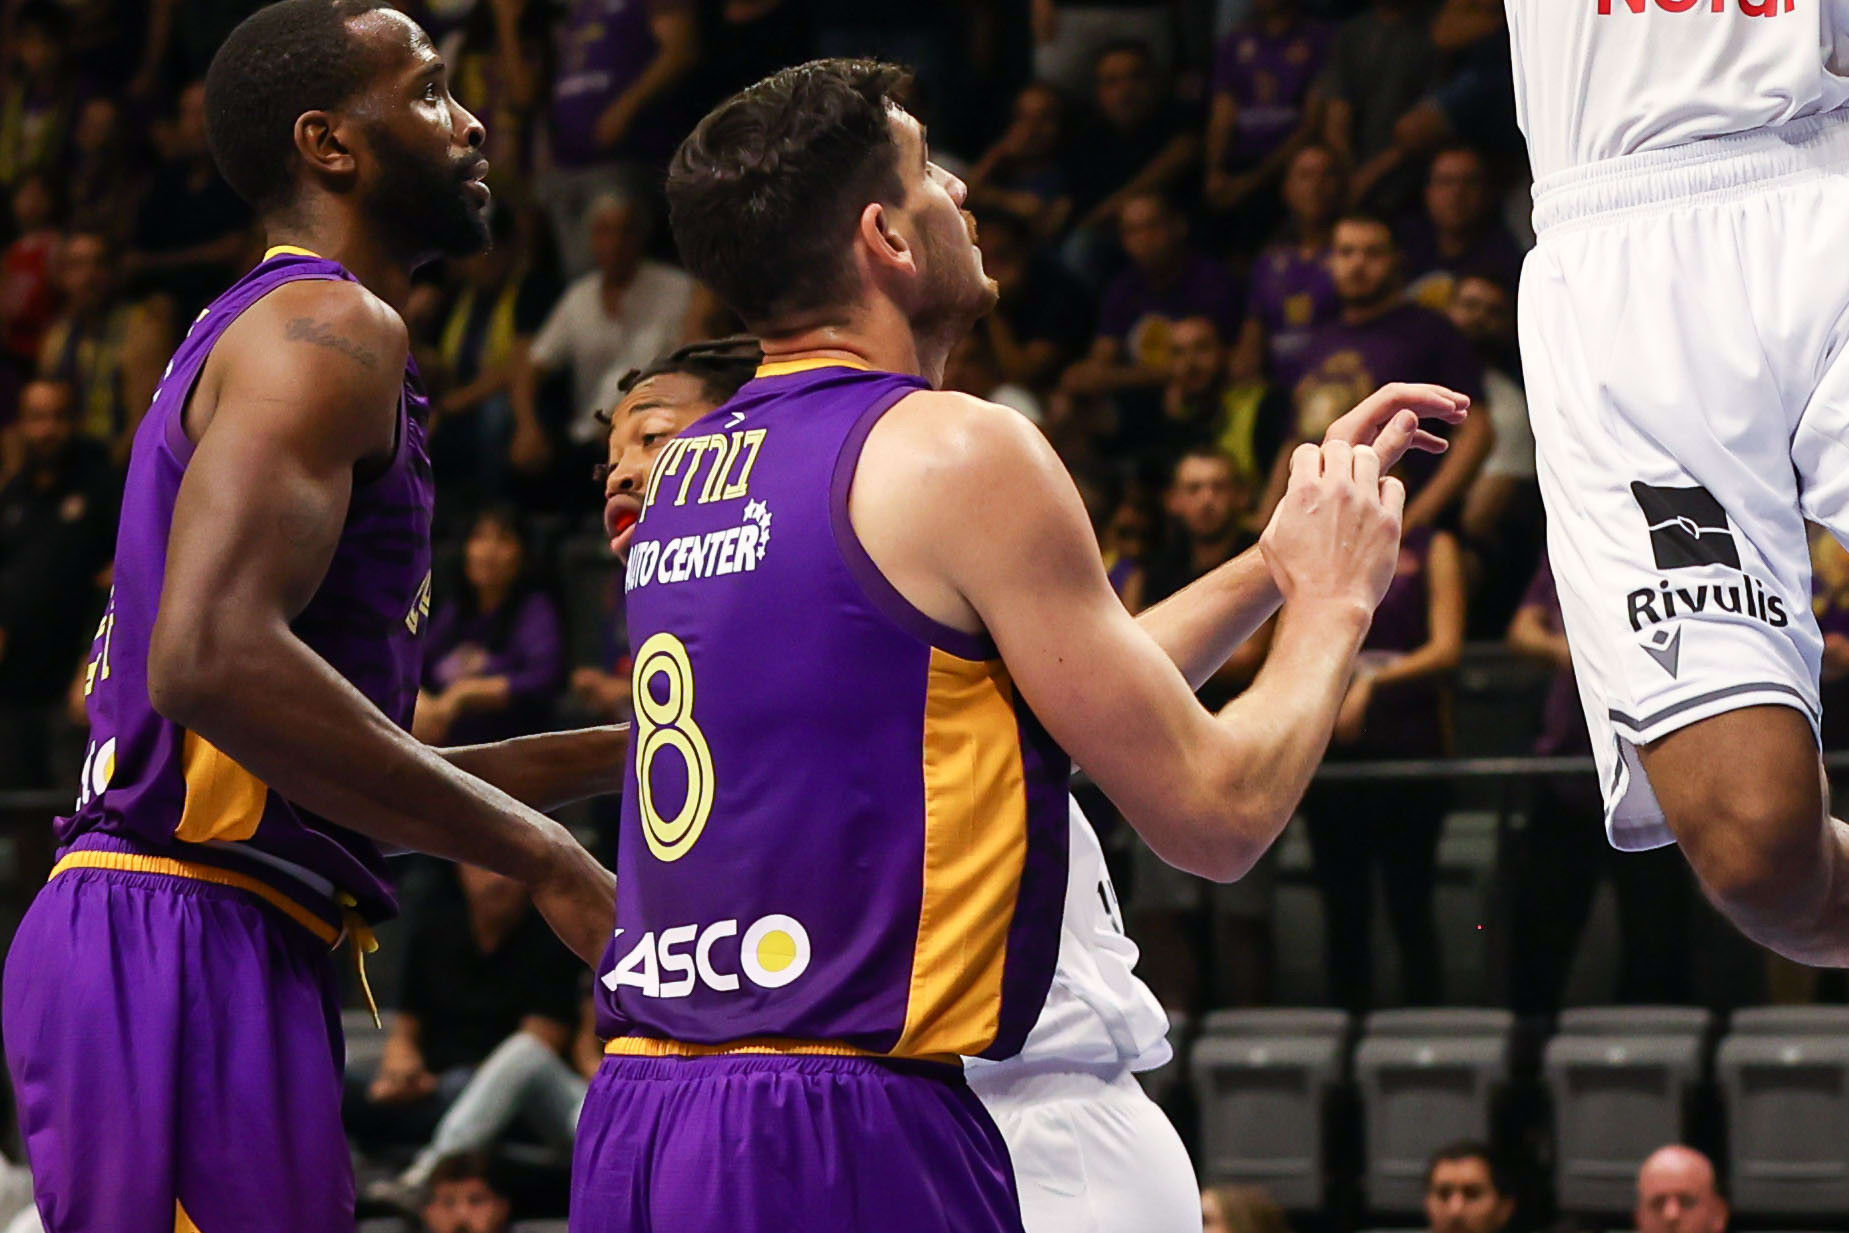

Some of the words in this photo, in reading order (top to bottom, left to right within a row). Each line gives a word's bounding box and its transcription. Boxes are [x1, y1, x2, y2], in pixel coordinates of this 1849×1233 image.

[657, 524, 760, 584] CENTER
[1626, 574, 1789, 632] Rivulis
[632, 632, 716, 862] 8
[601, 914, 811, 998] ASCO
